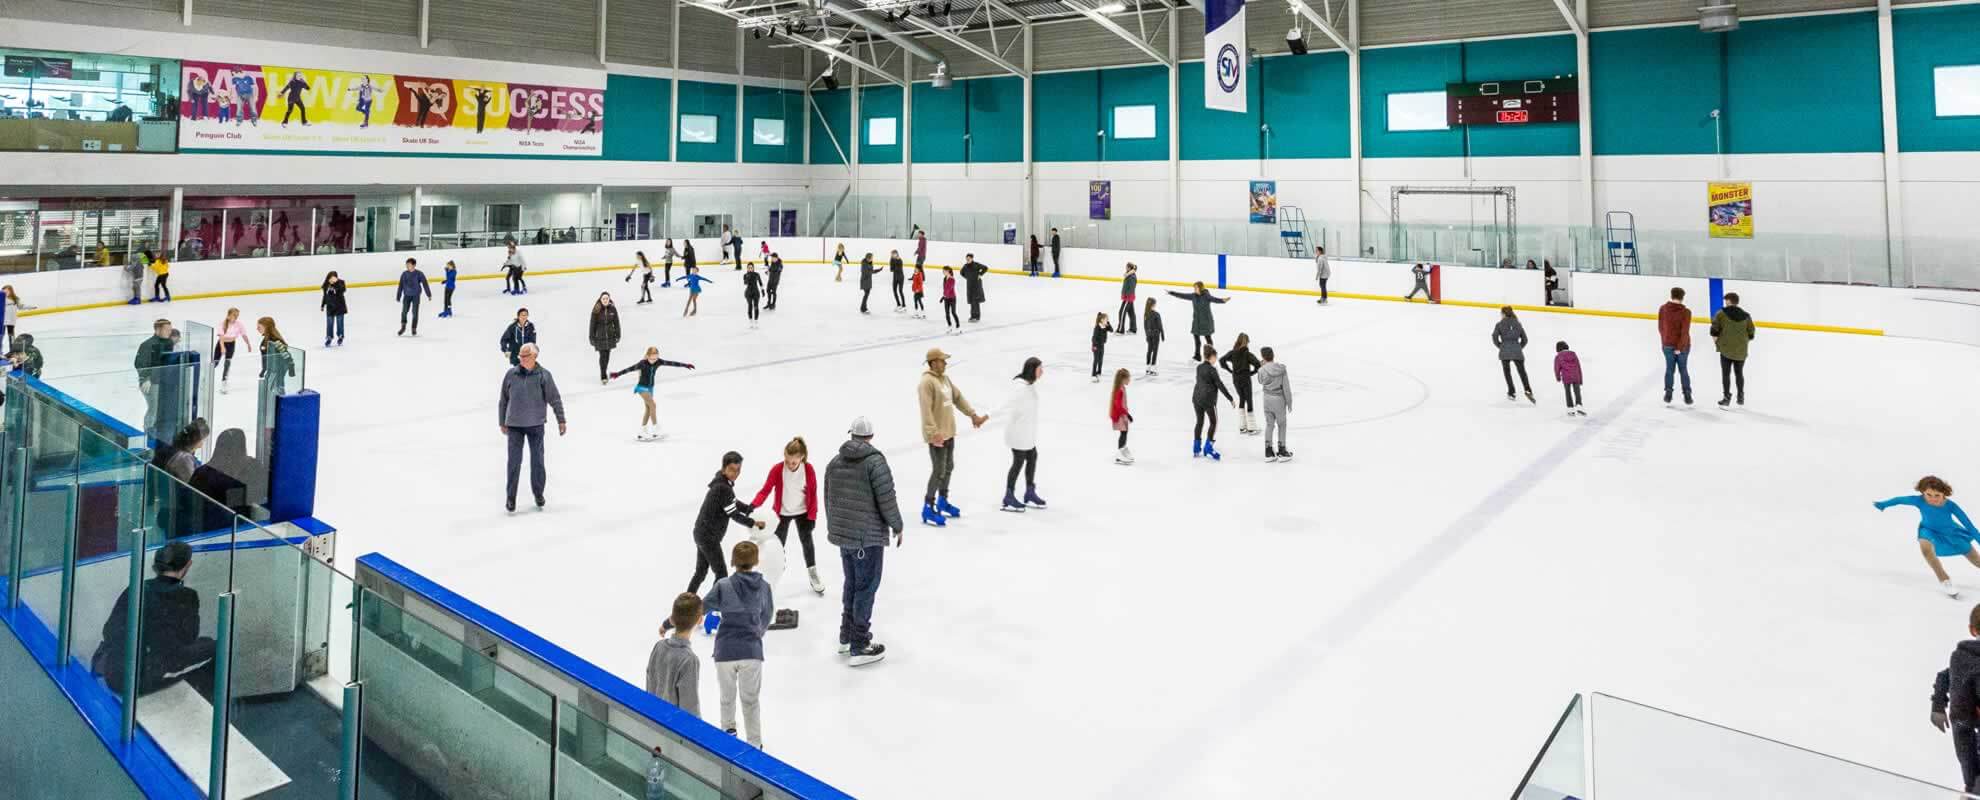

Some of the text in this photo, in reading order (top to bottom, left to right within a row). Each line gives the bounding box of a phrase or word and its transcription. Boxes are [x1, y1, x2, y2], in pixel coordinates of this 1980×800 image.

[463, 86, 604, 121] SUCCESS
[195, 131, 225, 139] Penguin
[1711, 187, 1749, 201] MONSTER
